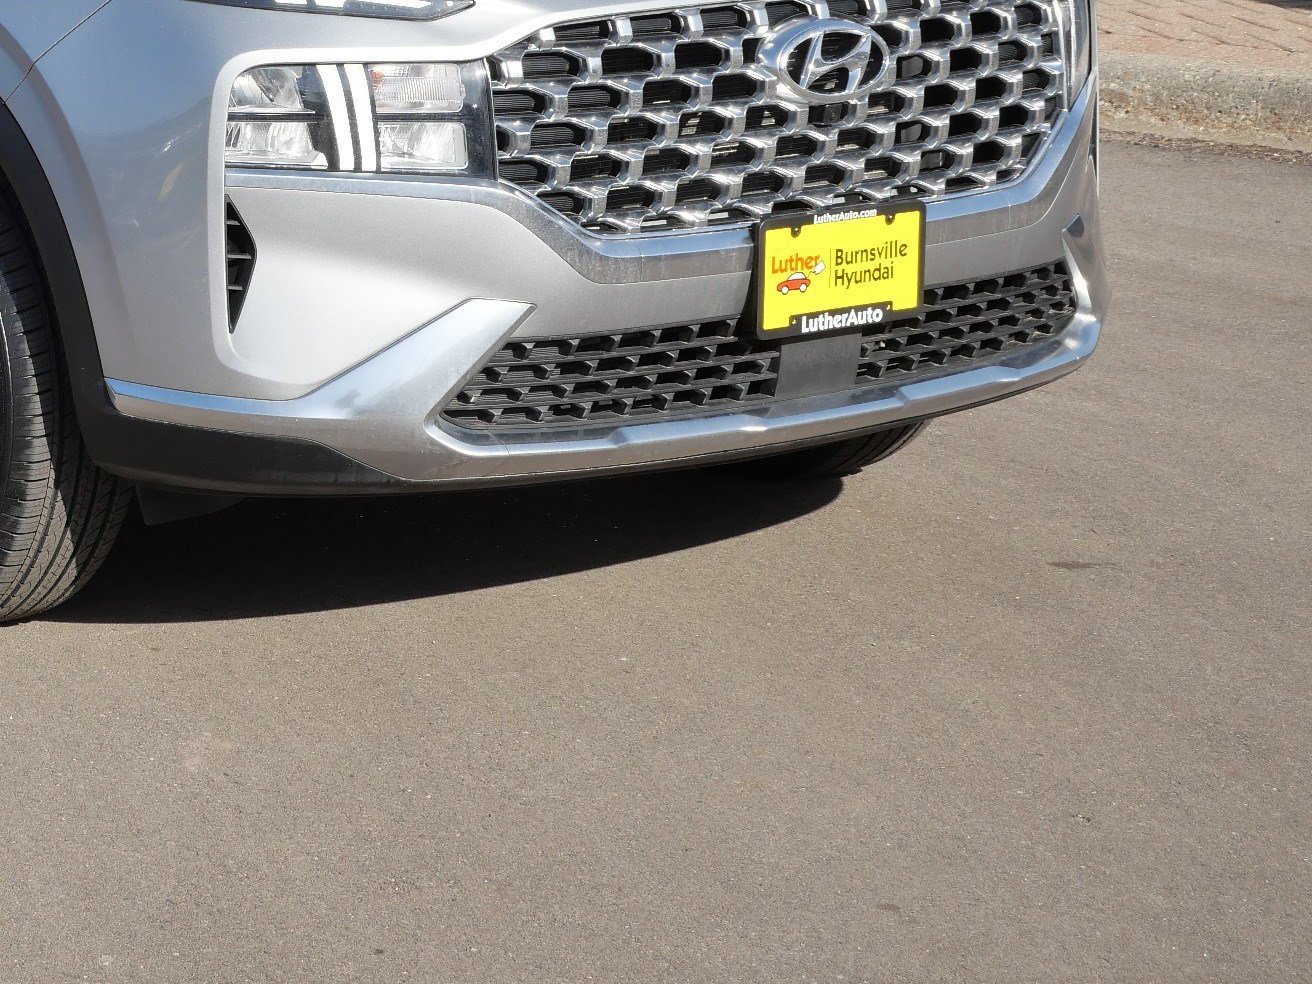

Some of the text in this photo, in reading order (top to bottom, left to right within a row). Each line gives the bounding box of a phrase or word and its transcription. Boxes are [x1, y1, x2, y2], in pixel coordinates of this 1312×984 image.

[813, 209, 877, 224] LutherAuto.com
[771, 253, 821, 274] Luther
[835, 240, 908, 266] Burnsville
[835, 262, 894, 289] Hyundai
[802, 307, 883, 333] LutherAuto
